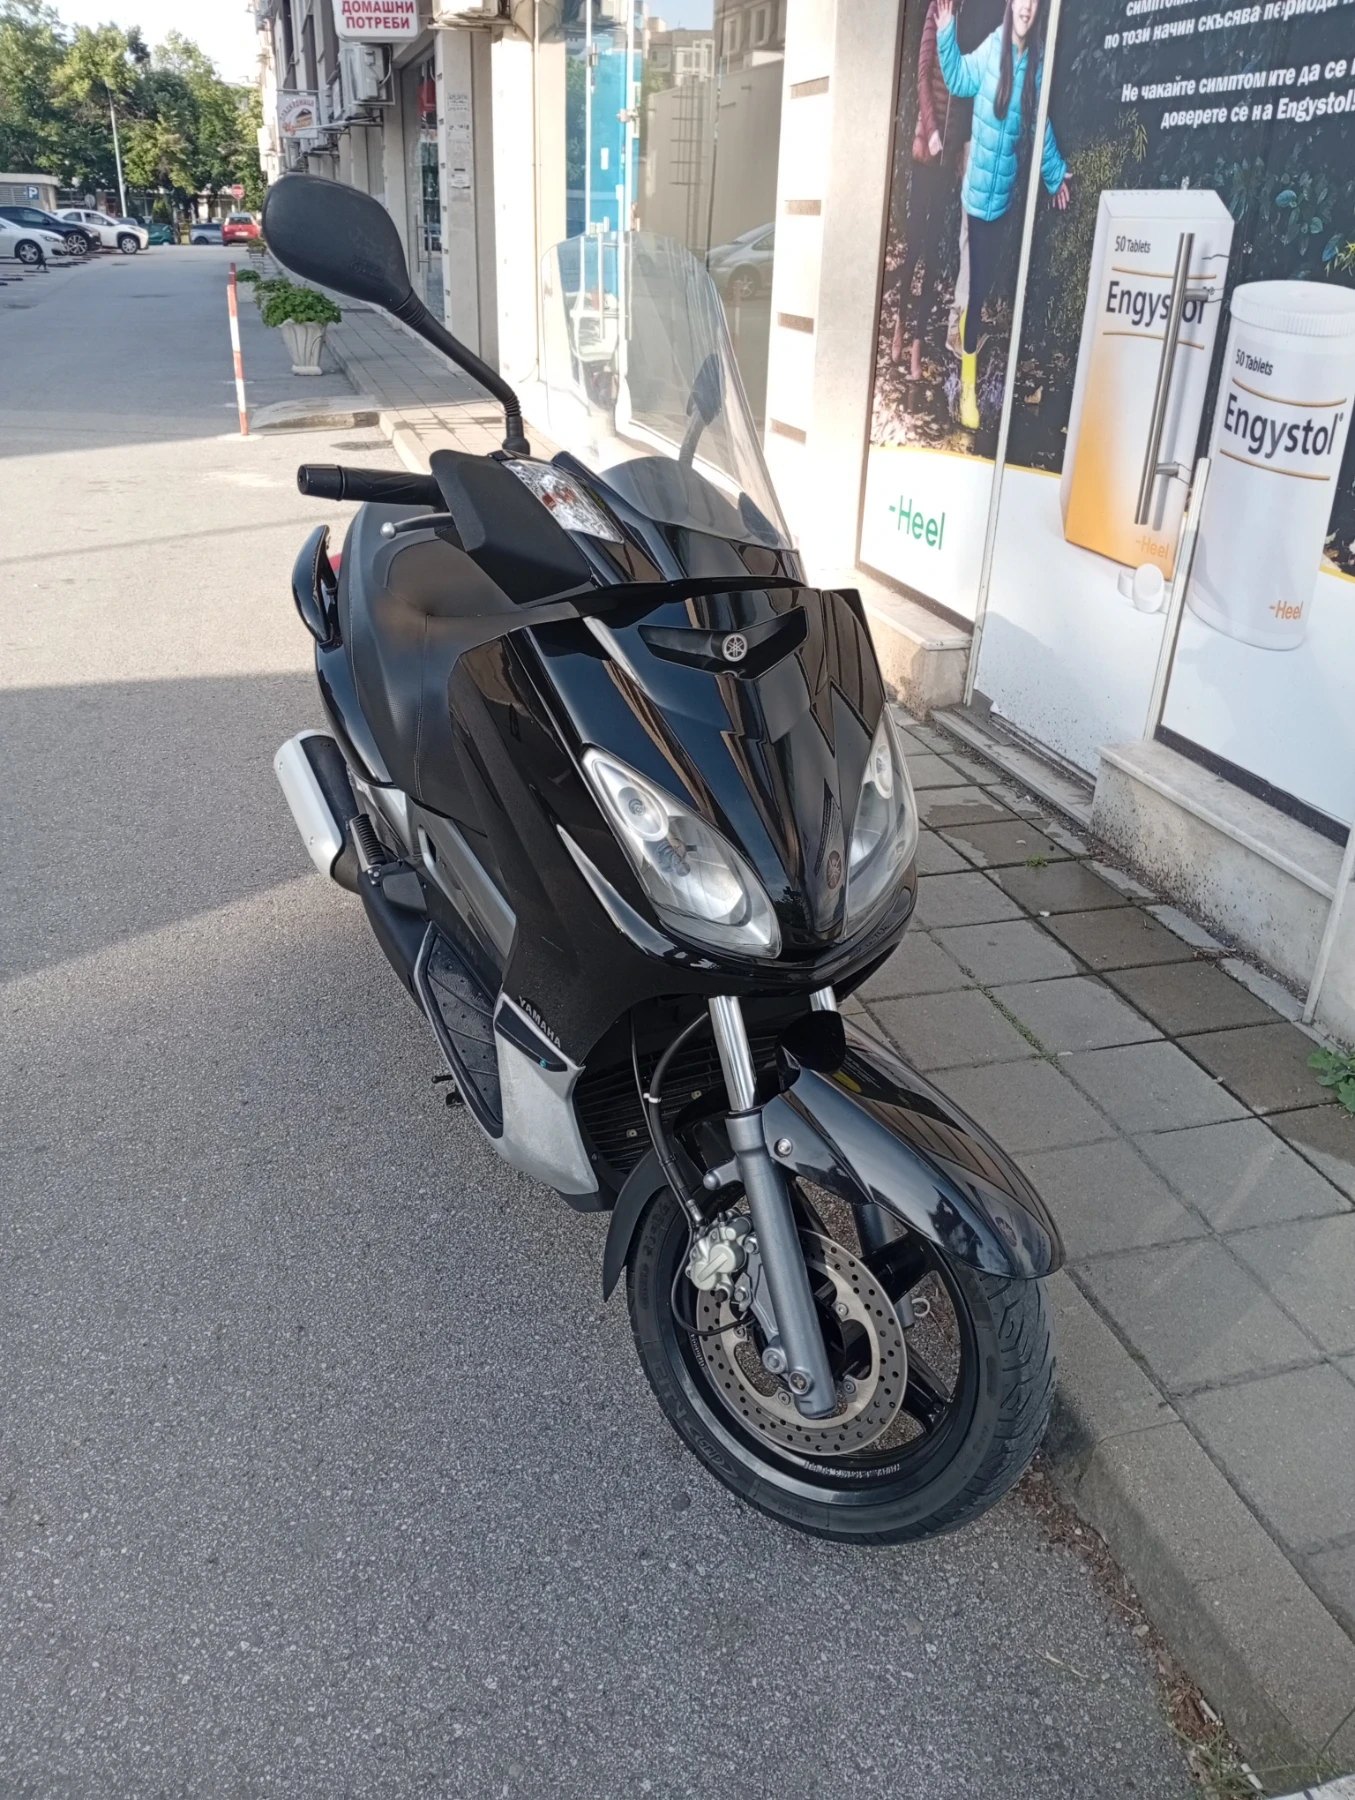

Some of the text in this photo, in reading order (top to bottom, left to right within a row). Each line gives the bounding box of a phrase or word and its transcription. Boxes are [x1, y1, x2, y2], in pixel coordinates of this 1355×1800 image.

[342, 0, 414, 15] ДОМАШНИ
[1126, 0, 1199, 16] симпто
[346, 16, 410, 29] ПОТРЕБИ
[1104, 33, 1120, 49] по
[1122, 27, 1151, 46] този
[1152, 18, 1196, 41] начин
[1198, 5, 1261, 32] скъсява
[1121, 83, 1139, 102] Не
[1141, 75, 1196, 100] чакайте
[1297, 63, 1321, 87] да
[1324, 59, 1347, 80] се
[1160, 107, 1228, 130] доверете
[1230, 105, 1249, 122] се
[1251, 103, 1273, 121] на
[1115, 235, 1151, 253] 50 Tablets
[1235, 349, 1273, 376] 50 Tablets
[518, 995, 562, 1048] YAMAHA
